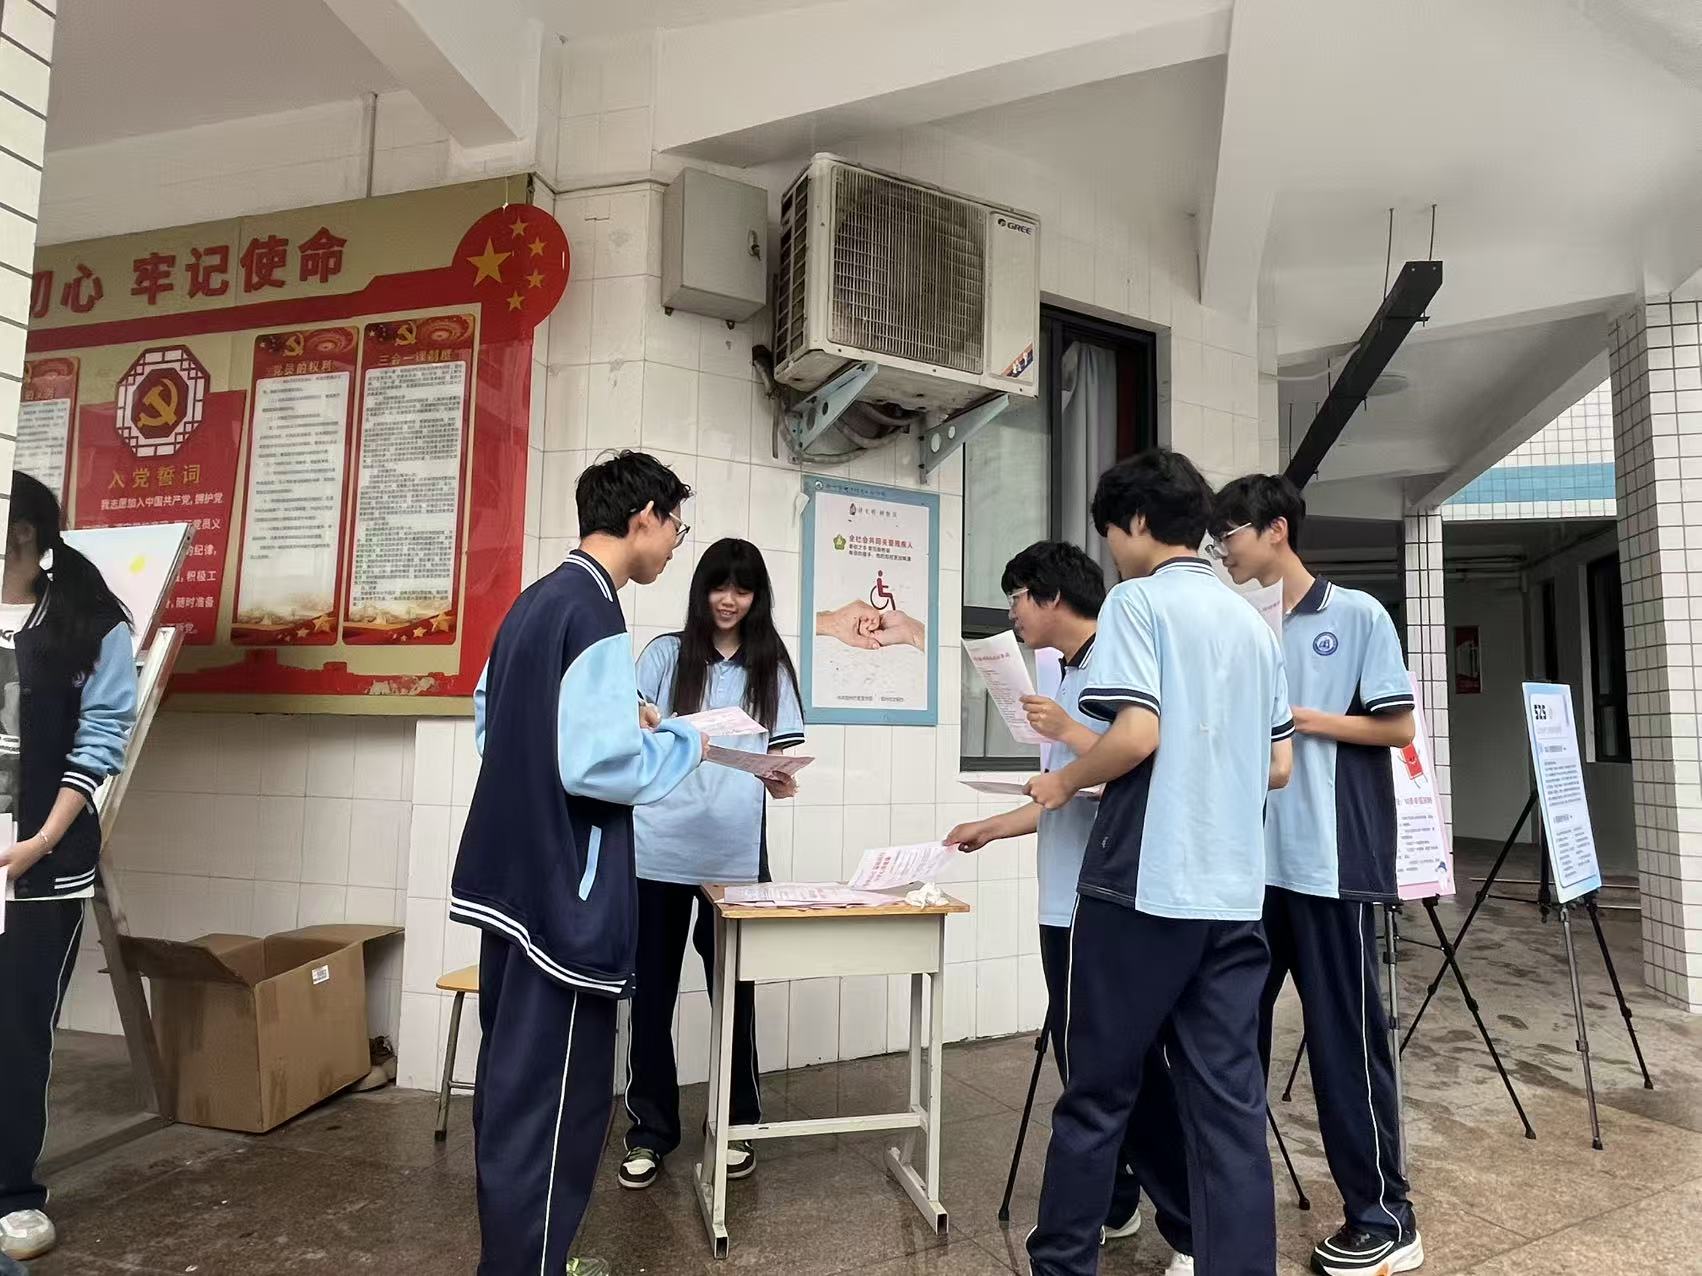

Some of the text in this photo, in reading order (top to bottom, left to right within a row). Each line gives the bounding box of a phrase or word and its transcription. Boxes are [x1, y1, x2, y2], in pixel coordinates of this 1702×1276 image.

[1007, 222, 1034, 235] GREE
[131, 226, 347, 305] 牢记使命
[108, 464, 200, 489] 入党誓词
